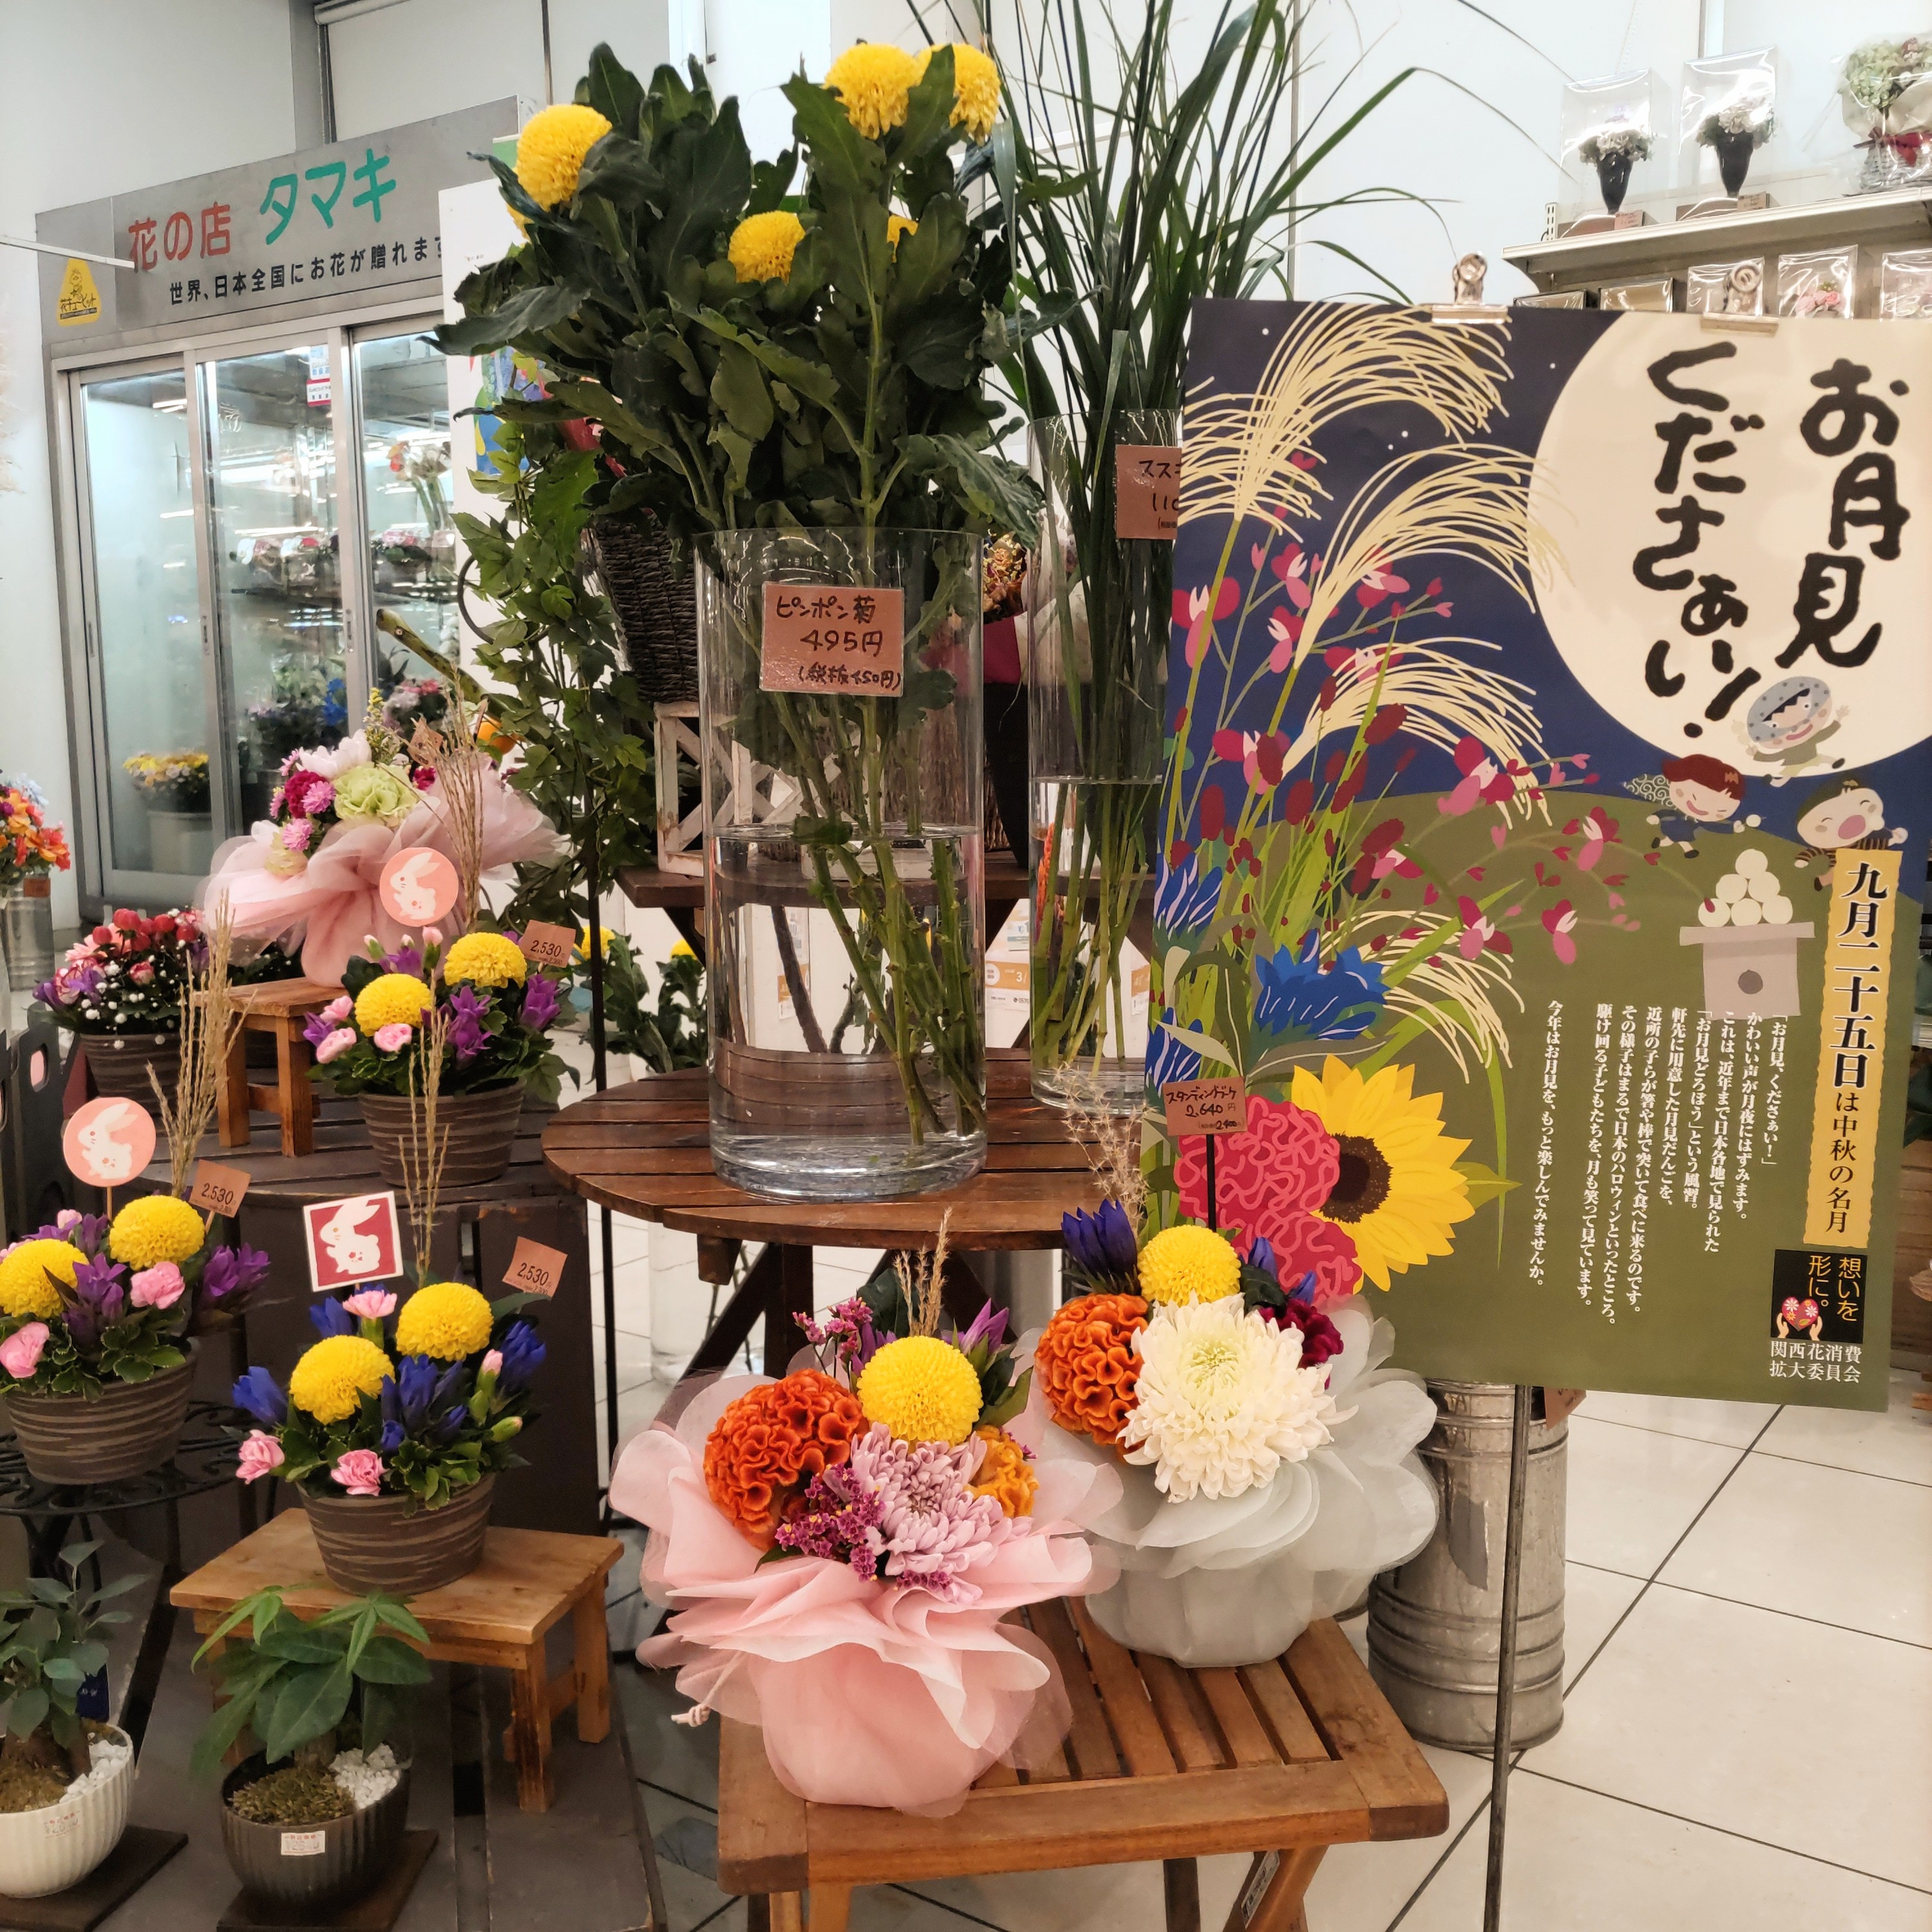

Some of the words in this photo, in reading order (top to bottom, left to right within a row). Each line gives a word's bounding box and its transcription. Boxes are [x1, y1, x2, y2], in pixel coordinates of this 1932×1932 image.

[129, 201, 233, 273] 花の店
[259, 147, 397, 245] タマキ
[1775, 358, 1911, 668] お月見
[776, 594, 876, 624] ピンポン菊
[800, 629, 883, 657] 495円
[1704, 1011, 1737, 1253] これは、近年まで日本各地で見られた
[1732, 1012, 1763, 1219] かわいい声が月夜にはずみます。
[1808, 1255, 1832, 1307] 形に。
[1837, 1257, 1862, 1321] 想いを
[1769, 1360, 1861, 1383] 拡大委員会
[1770, 1340, 1862, 1364] 関西花消費
